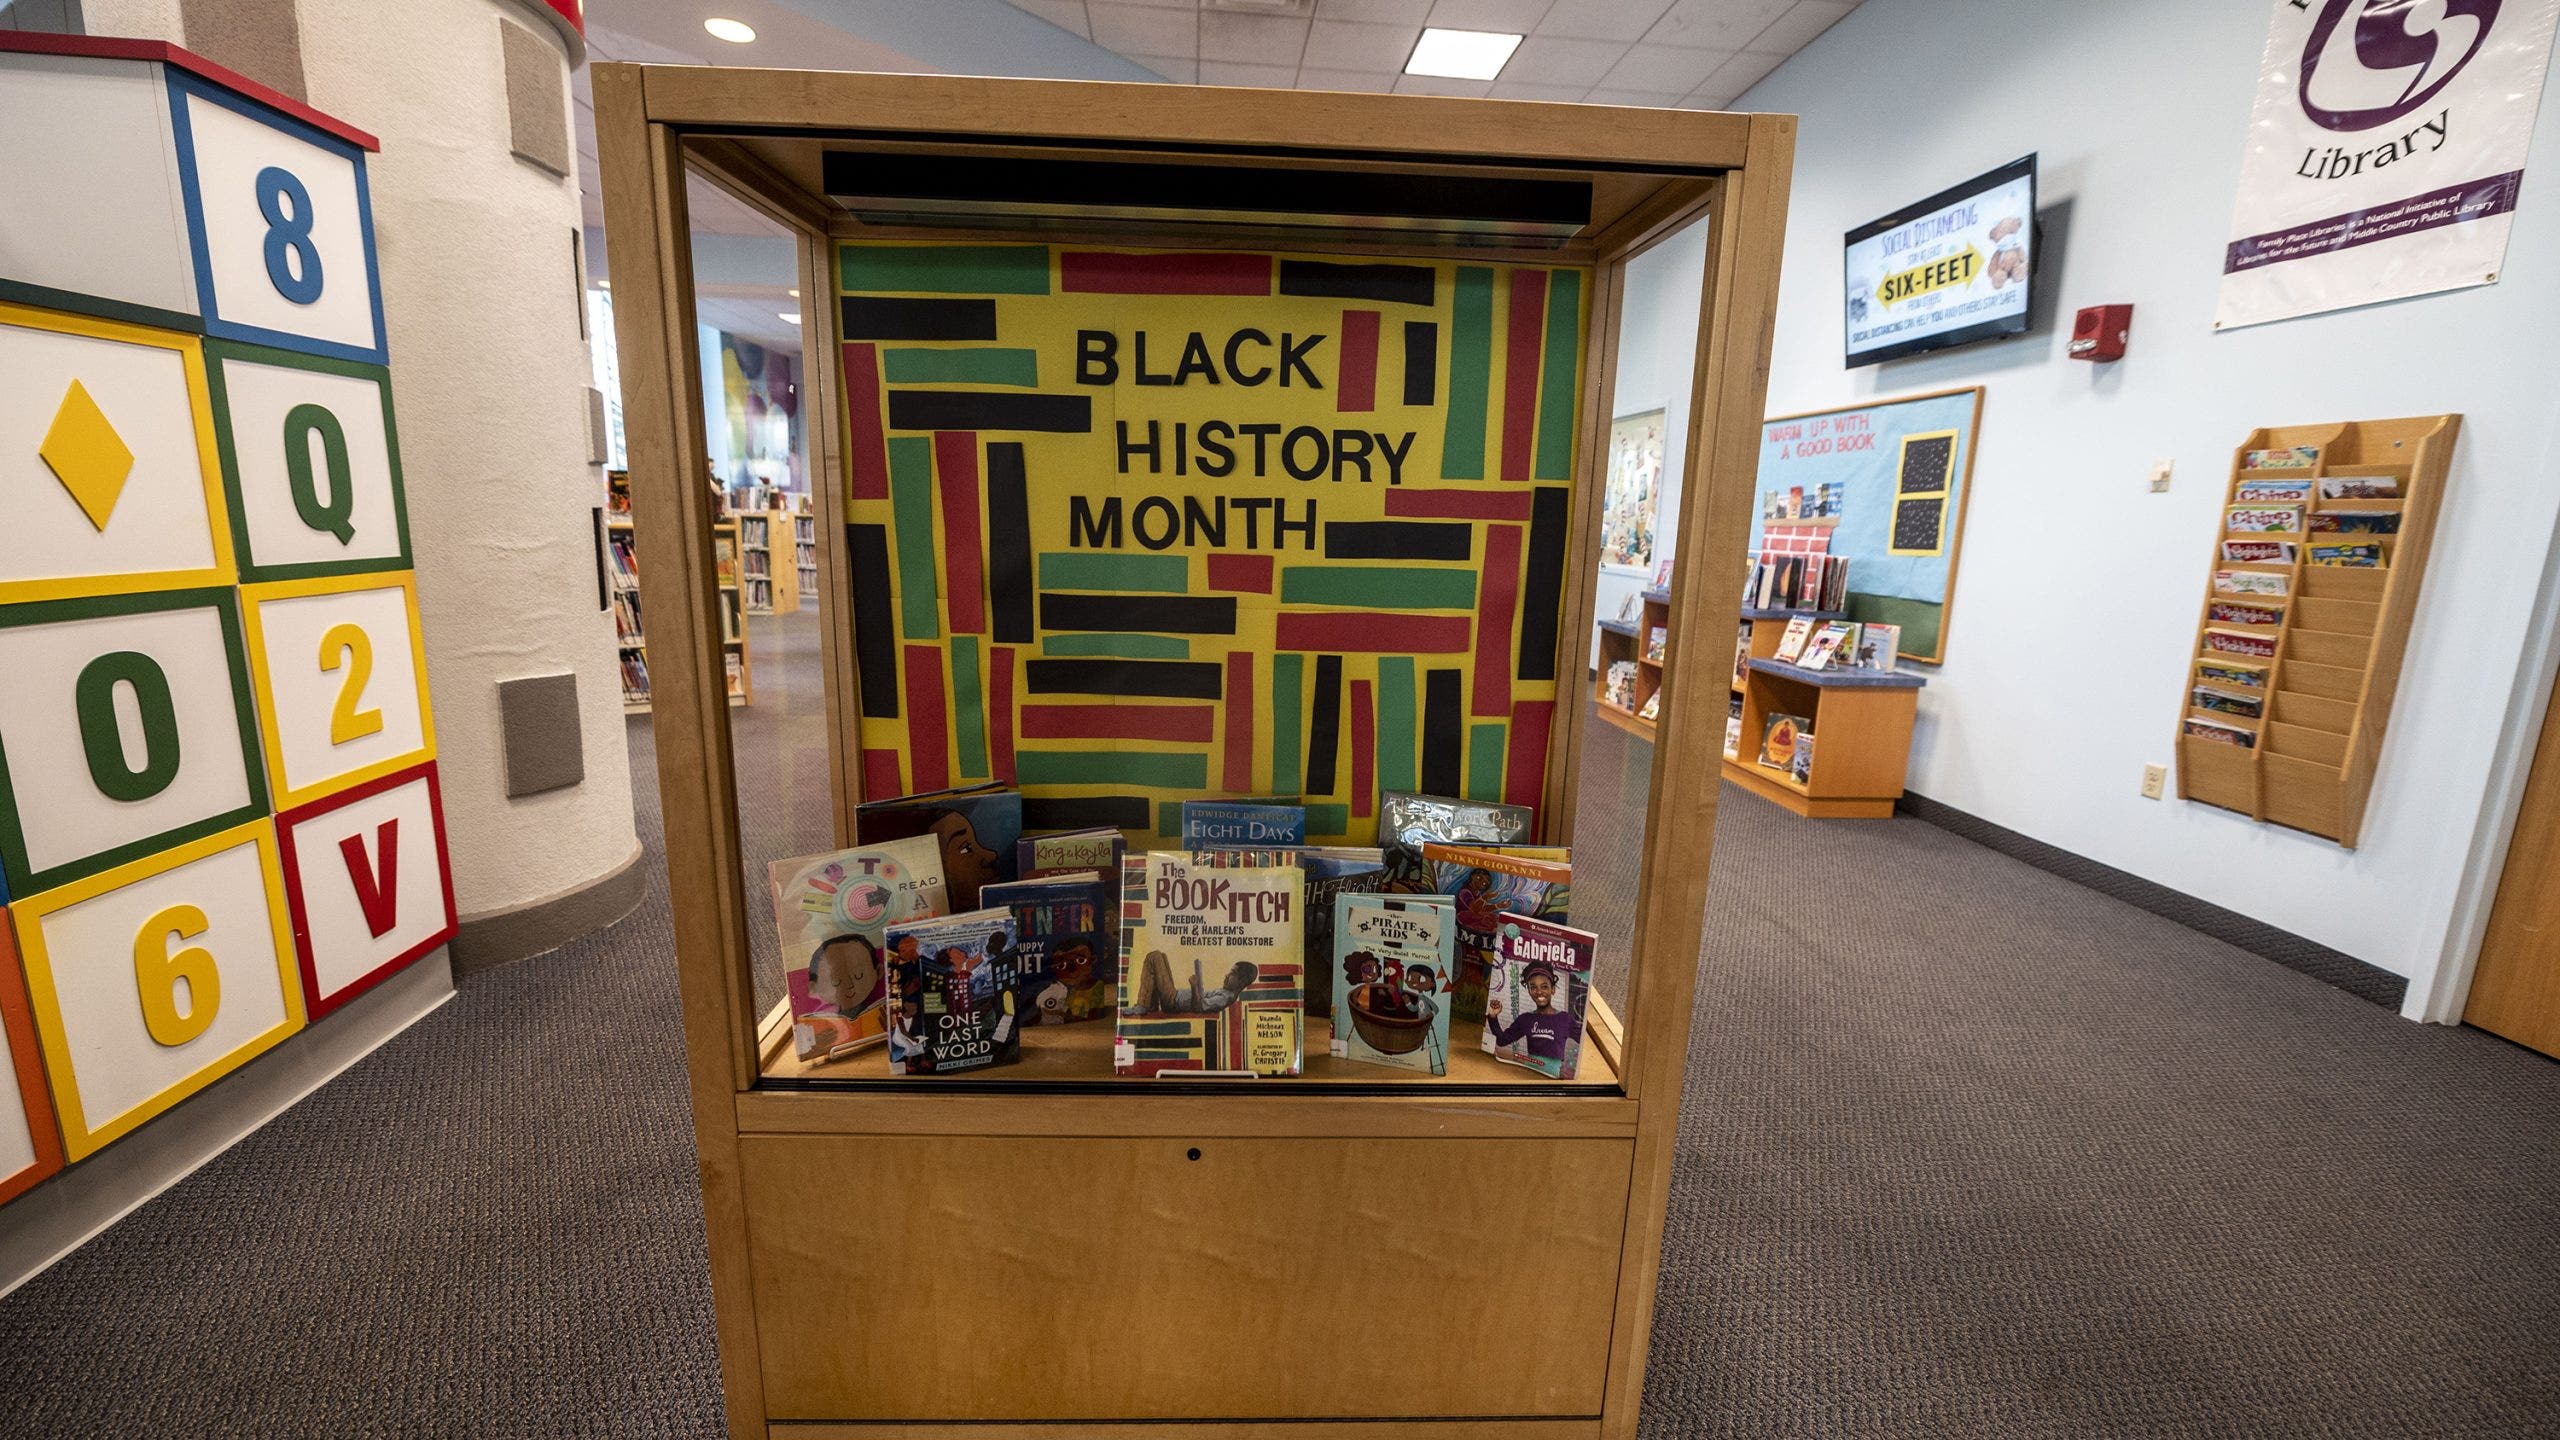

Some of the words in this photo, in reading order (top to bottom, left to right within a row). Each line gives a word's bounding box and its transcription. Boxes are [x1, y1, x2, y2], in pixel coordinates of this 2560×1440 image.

[2296, 108, 2450, 180] Library
[2309, 223, 2346, 238] Libraries
[2366, 207, 2405, 224] National
[2405, 197, 2446, 214] Initiative
[2448, 191, 2463, 204] of
[2379, 216, 2420, 234] Country
[2420, 209, 2452, 224] Public
[2453, 199, 2496, 215] Library
[256, 166, 324, 305] 8
[1885, 253, 1975, 301] SIX-FEET
[1076, 328, 1328, 389] BLACK
[1768, 424, 1802, 442] WARM
[1809, 419, 1828, 437] UP
[1833, 413, 1870, 433] WITH
[1116, 420, 1417, 485] HISTORY
[1780, 443, 1790, 460] A
[1796, 438, 1832, 458] GOOD
[1836, 432, 1876, 453] BOOK
[284, 403, 356, 546] Q
[1069, 495, 1317, 550] MONTH
[319, 623, 384, 745] 2
[1192, 809, 1239, 819] EDWIDGE
[1490, 809, 1522, 831] Path
[1036, 844, 1066, 865] King
[1075, 842, 1112, 865] Kayla
[1446, 852, 1480, 866] NIKKI
[1483, 856, 1543, 878] GIOVANNI
[339, 818, 399, 939] V
[1161, 862, 1185, 878] The
[899, 876, 938, 891] READ
[912, 894, 928, 911] A
[1156, 878, 1230, 911] BOOK
[1228, 890, 1290, 924] ITCH
[1161, 925, 1188, 935] TRUTH
[1191, 925, 1199, 936] &
[1201, 925, 1244, 935] HARLEM'S
[1165, 914, 1207, 925] FREEDOM,
[1372, 917, 1418, 932] PIRATE
[1180, 936, 1223, 946] GREATEST
[1226, 936, 1274, 947] BOOKSTORE
[1380, 928, 1409, 940] KIDS
[1378, 947, 1393, 957] Very
[134, 905, 221, 1047] 6
[939, 1010, 981, 1029] ONE
[1531, 1021, 1555, 1034] dream
[939, 1025, 983, 1045] LAST
[933, 1040, 991, 1061] WORD
